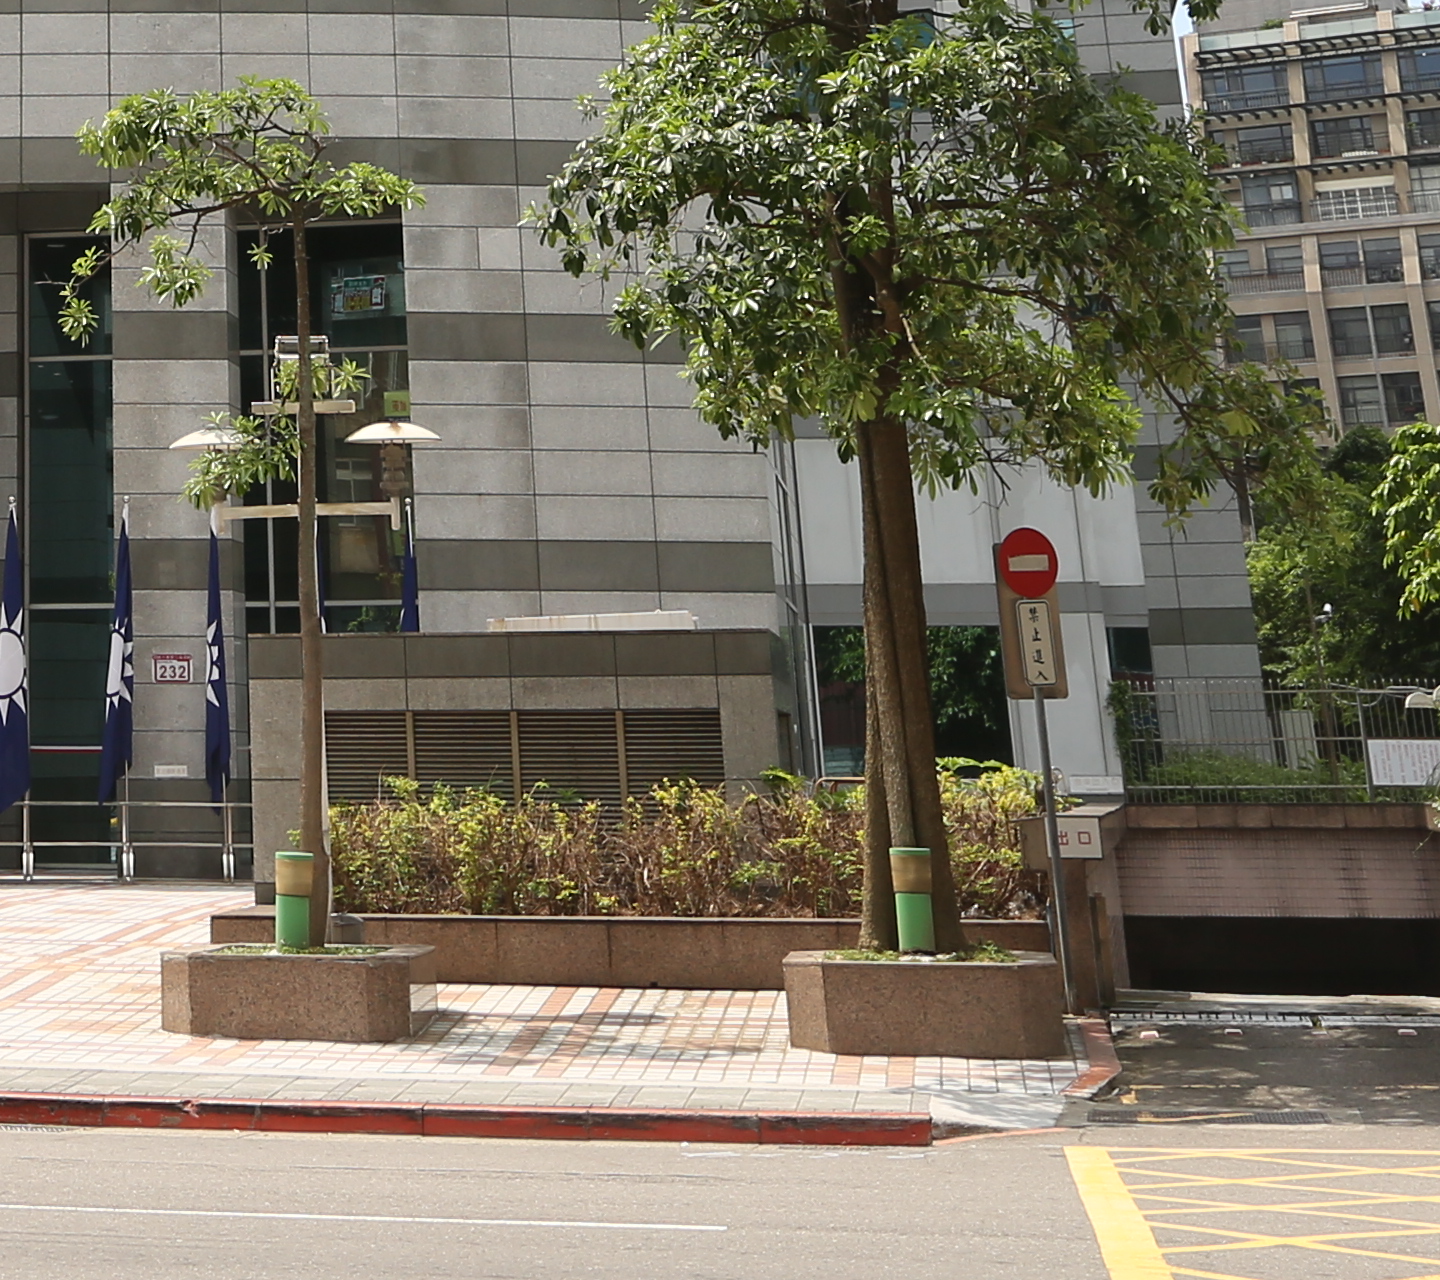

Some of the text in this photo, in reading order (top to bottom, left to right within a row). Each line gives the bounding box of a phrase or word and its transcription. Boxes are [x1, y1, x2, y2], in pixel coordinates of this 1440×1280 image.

[1028, 606, 1048, 681] 禁止進入
[159, 664, 187, 679] 232
